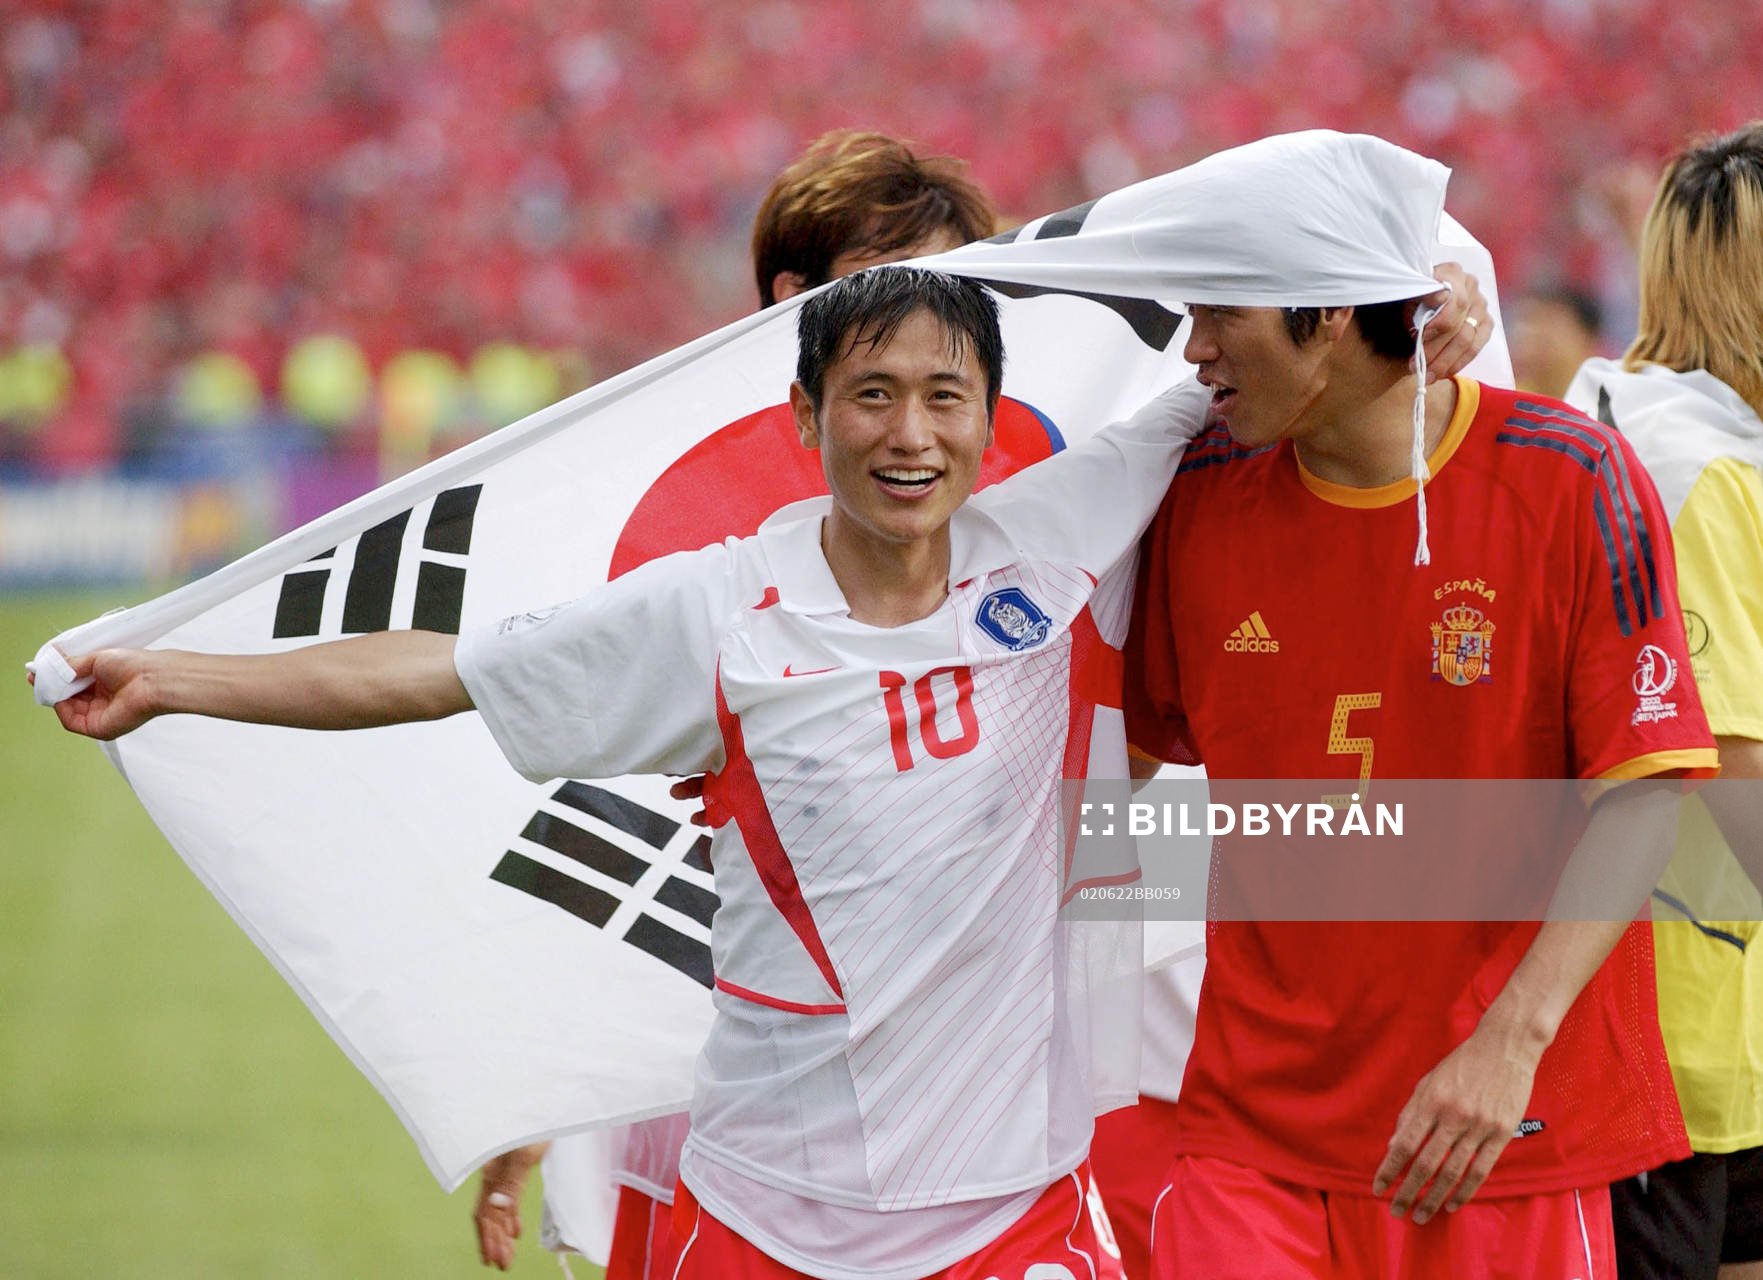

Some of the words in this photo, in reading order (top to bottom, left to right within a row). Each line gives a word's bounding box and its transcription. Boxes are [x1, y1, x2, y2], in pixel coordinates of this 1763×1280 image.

[1434, 578, 1496, 603] ESPAÑA
[1224, 637, 1280, 653] adidas
[879, 666, 980, 772] 10
[1321, 692, 1382, 810] 5
